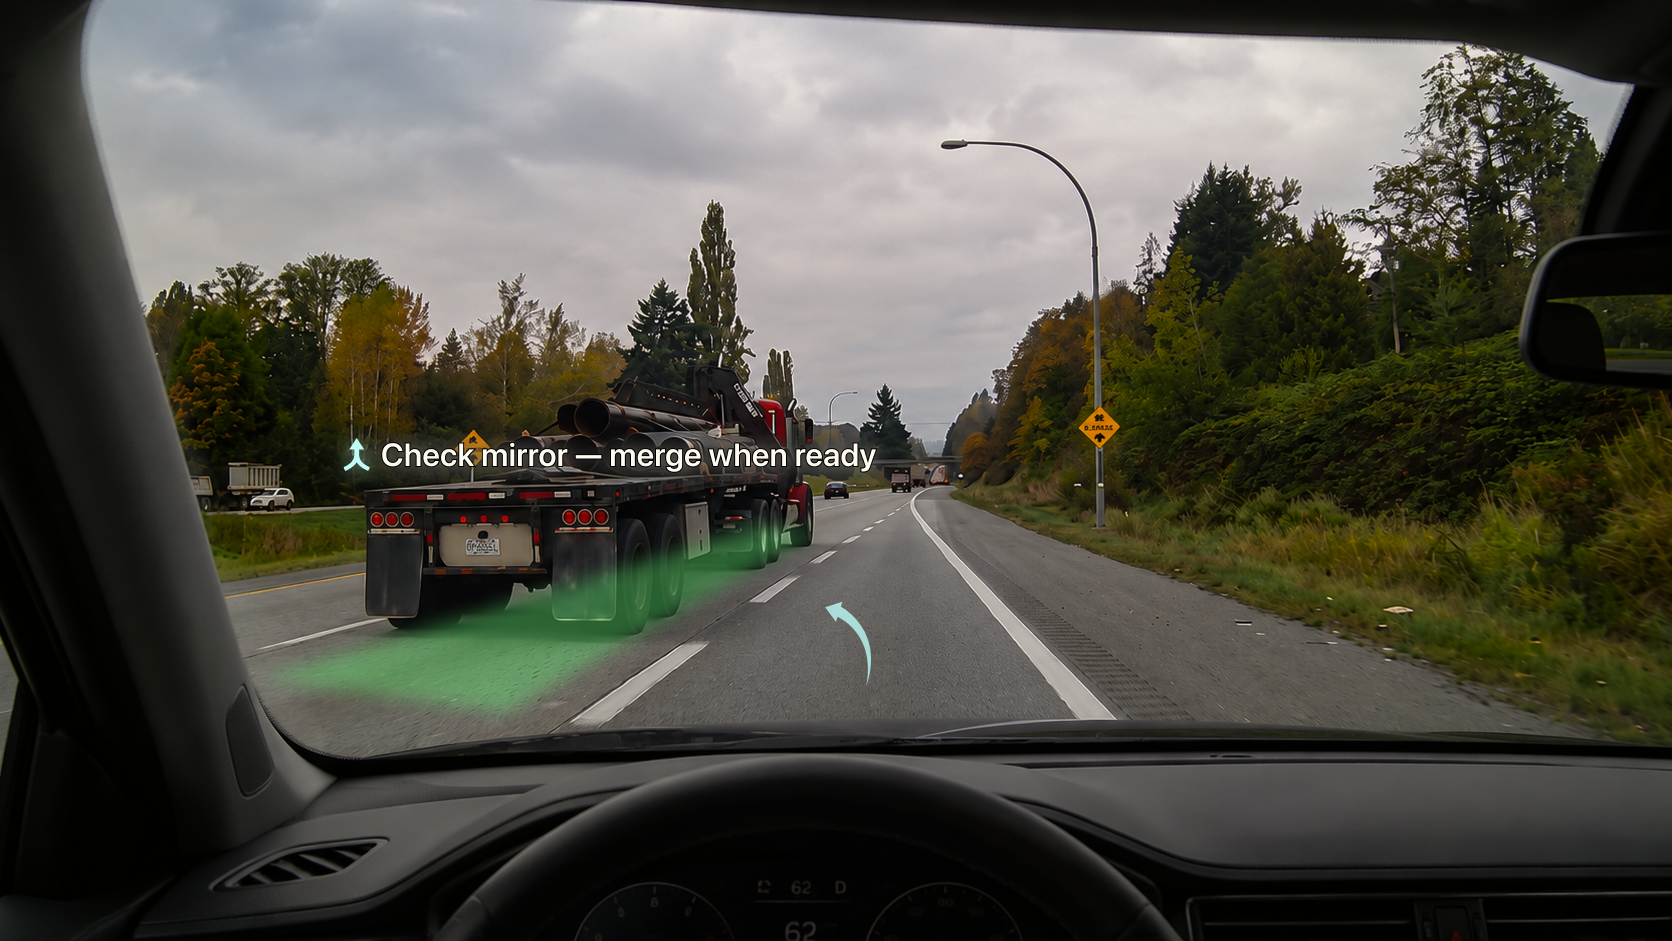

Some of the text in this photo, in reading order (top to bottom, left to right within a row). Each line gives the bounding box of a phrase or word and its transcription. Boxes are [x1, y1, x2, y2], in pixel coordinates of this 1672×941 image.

[790, 879, 812, 895] 62
[834, 879, 847, 895] D
[784, 920, 817, 941] 62
